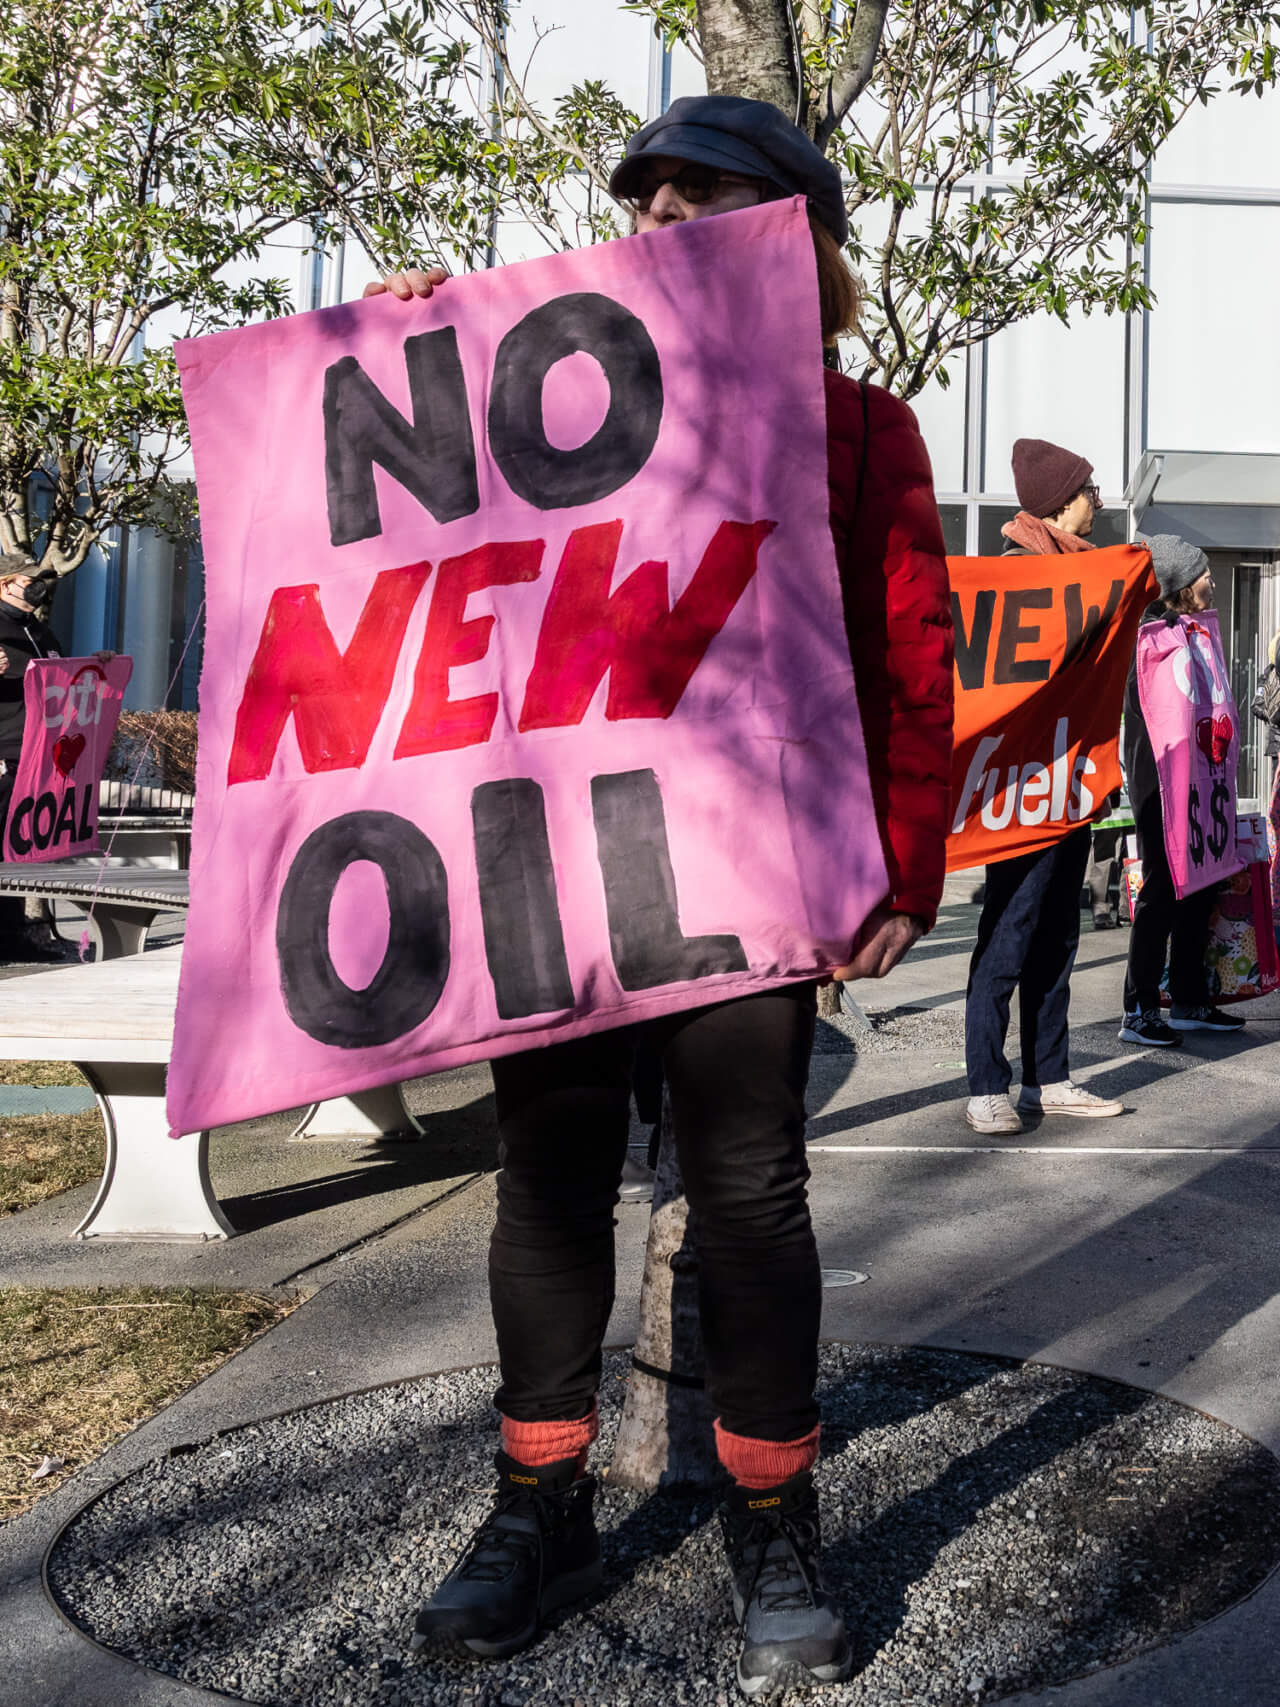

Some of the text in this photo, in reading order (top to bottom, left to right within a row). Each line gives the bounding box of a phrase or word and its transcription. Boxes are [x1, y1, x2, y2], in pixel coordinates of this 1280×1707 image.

[323, 291, 664, 547] NO
[227, 517, 779, 787] NEW
[951, 580, 1125, 690] NEW
[10, 784, 94, 855] COAL
[276, 768, 750, 1049] OIL
